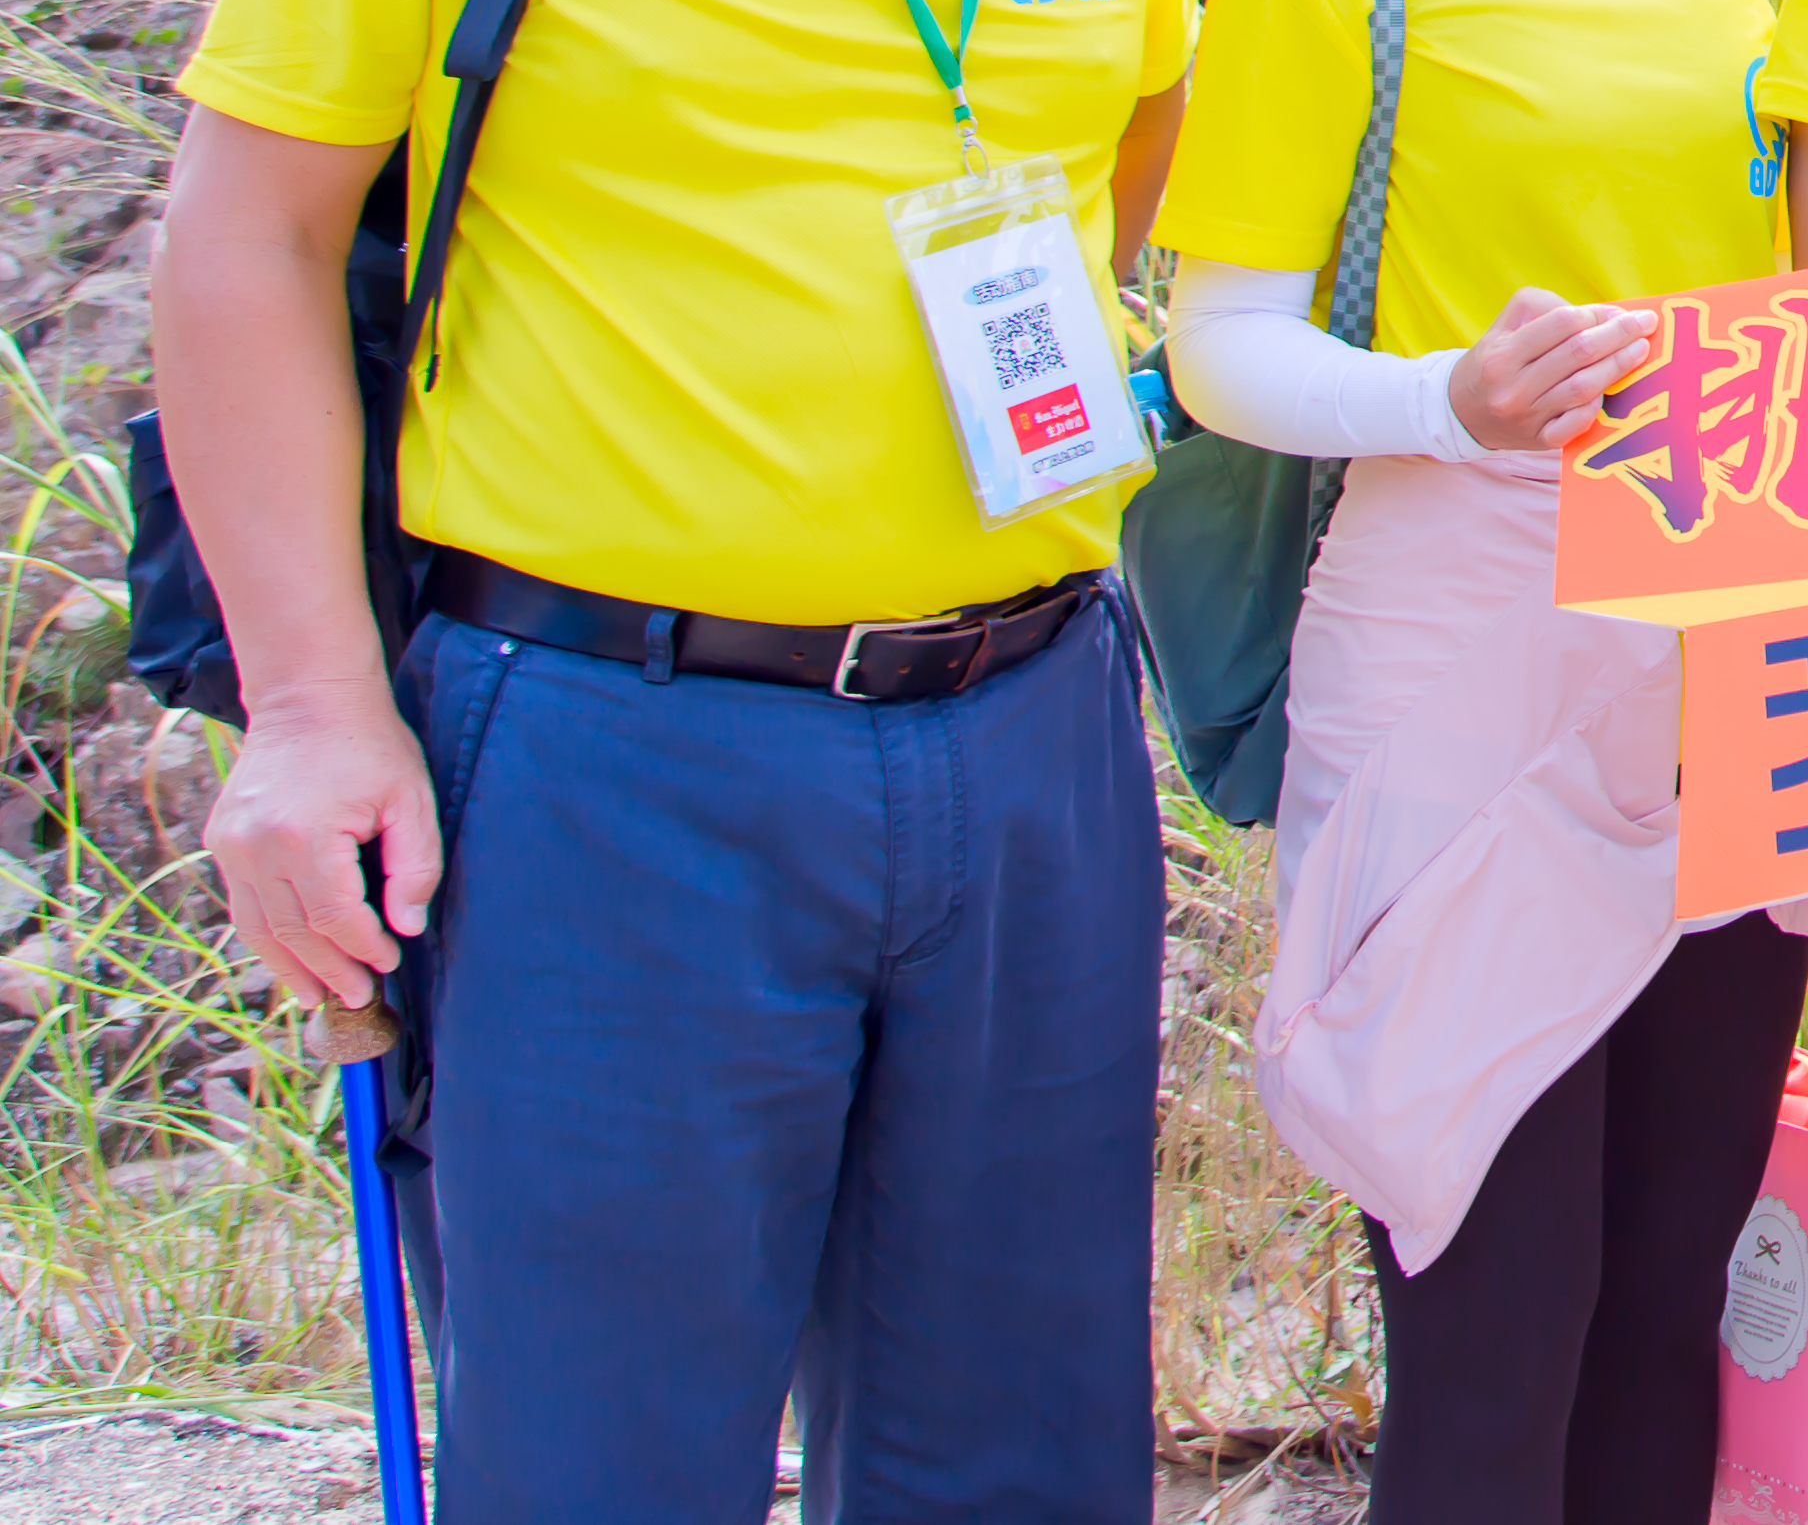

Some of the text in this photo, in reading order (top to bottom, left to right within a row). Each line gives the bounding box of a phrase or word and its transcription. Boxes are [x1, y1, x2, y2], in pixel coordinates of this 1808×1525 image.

[1735, 1260, 1797, 1295] Thanks to all
